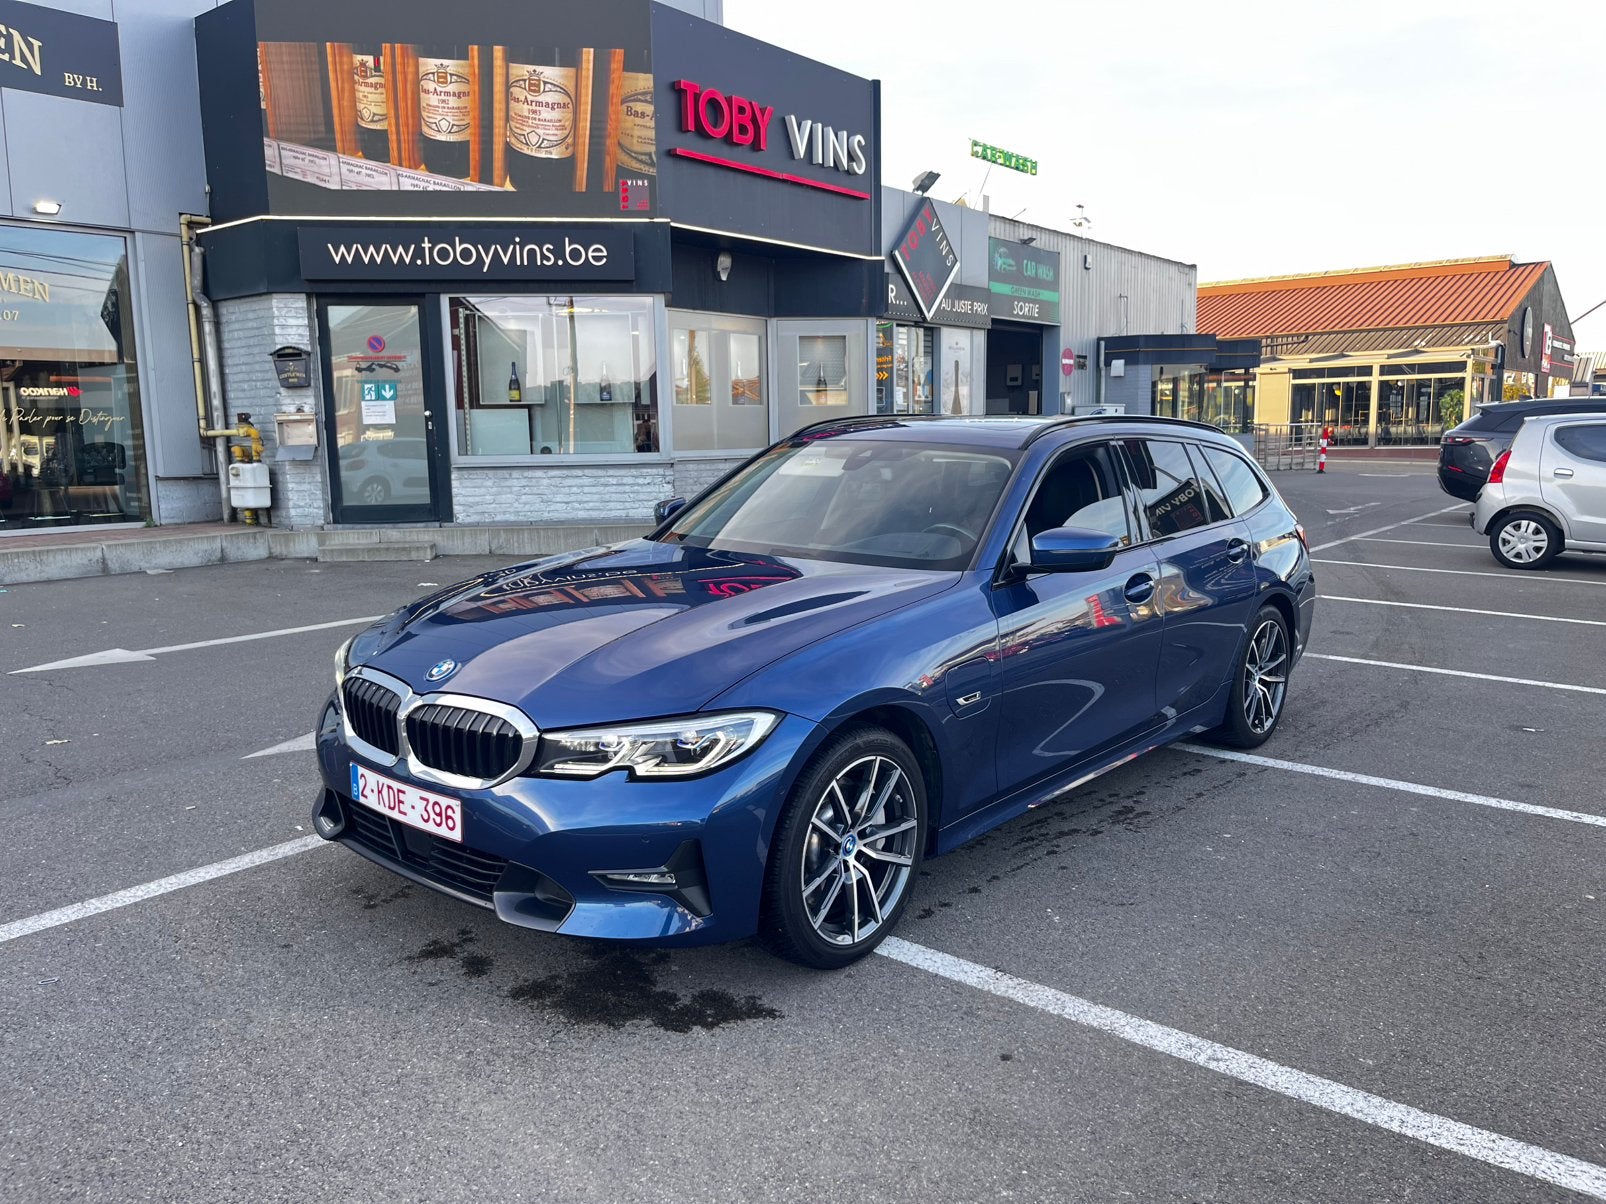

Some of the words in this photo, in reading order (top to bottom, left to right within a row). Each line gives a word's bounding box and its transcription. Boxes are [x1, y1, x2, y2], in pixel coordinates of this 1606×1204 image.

[64, 72, 82, 88] BY
[85, 76, 103, 91] H.
[674, 79, 774, 151] TOBY
[784, 114, 866, 175] VINS
[627, 179, 649, 187] VINS
[900, 206, 934, 261] TOBY
[931, 217, 954, 267] VINS
[327, 236, 608, 272] www.tobyvins.be
[1023, 259, 1037, 278] CAR
[1037, 263, 1055, 281] WASH
[940, 298, 951, 311] AU
[952, 300, 972, 314] JUSTE
[973, 302, 988, 315] PRIX
[1013, 301, 1039, 317] SORTIE
[9, 406, 42, 424] Parler
[353, 783, 359, 796] B
[359, 773, 456, 832] 2-KDE-396
